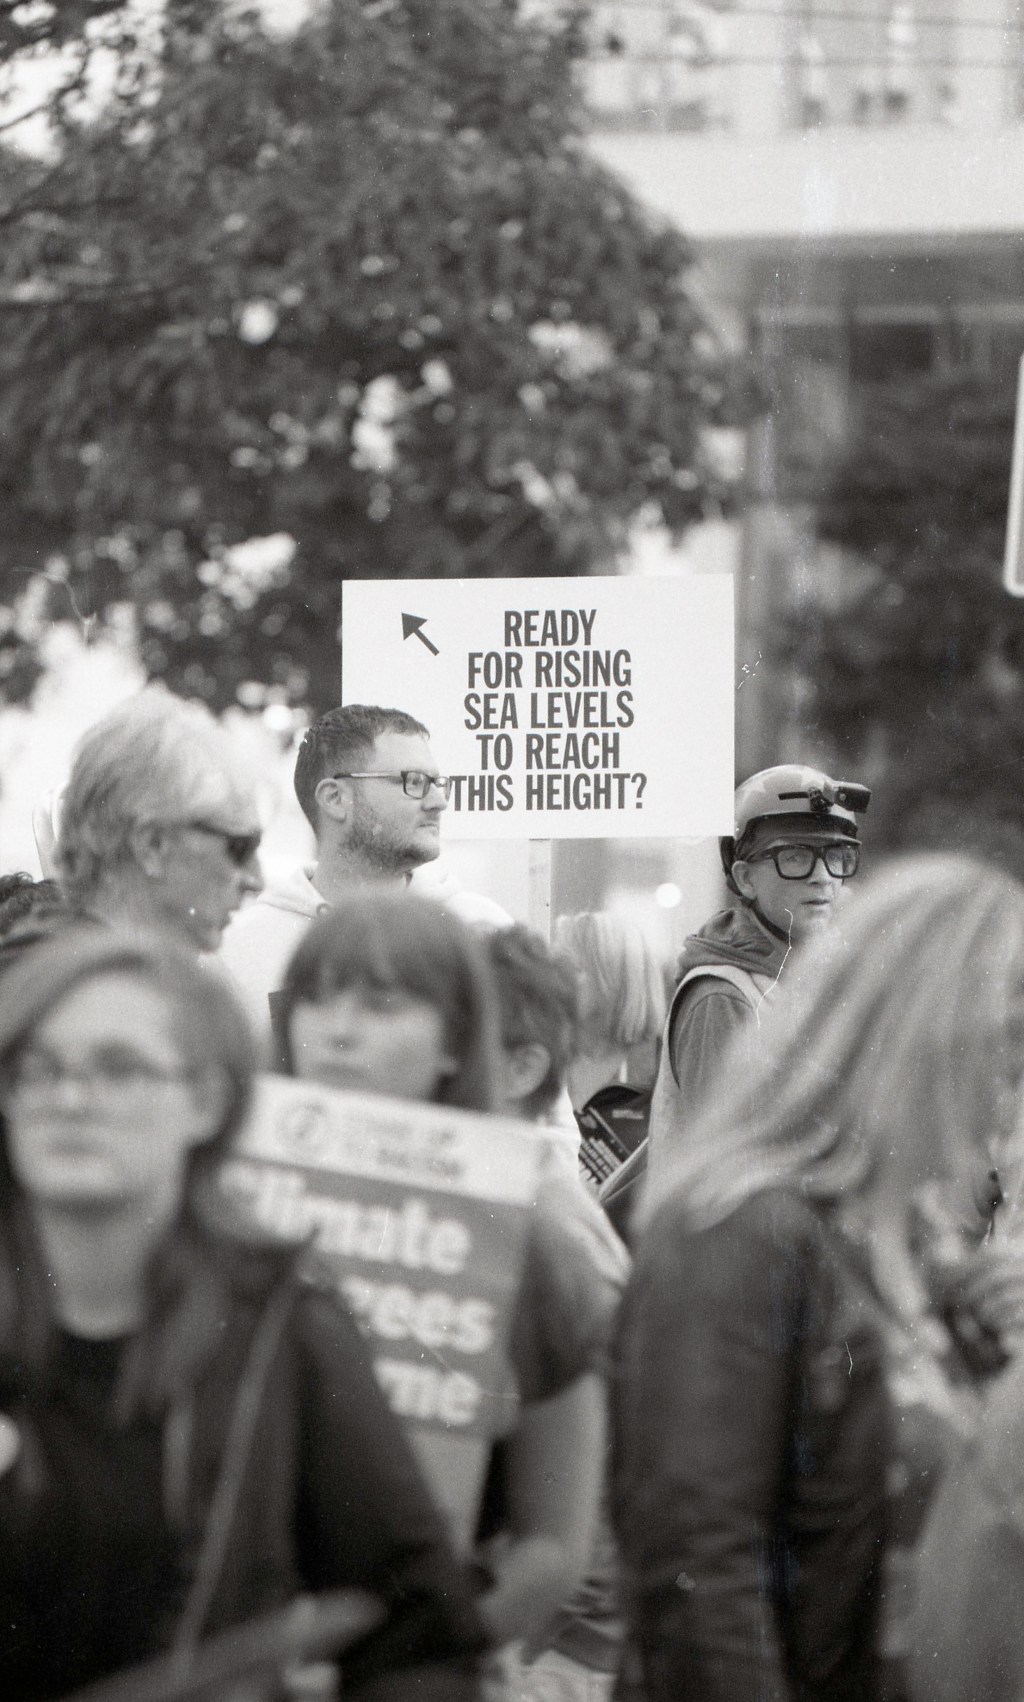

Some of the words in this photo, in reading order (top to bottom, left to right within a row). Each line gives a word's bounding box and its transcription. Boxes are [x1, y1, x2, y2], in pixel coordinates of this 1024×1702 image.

[504, 609, 597, 647] READY
[468, 651, 523, 689] FOR
[535, 649, 632, 688] RISING
[463, 692, 519, 731] SEA
[530, 690, 635, 729] LEVELS
[475, 733, 513, 771] TO
[525, 731, 620, 770] REACH
[448, 774, 514, 812] THIS
[525, 772, 647, 811] HEIGHT?
